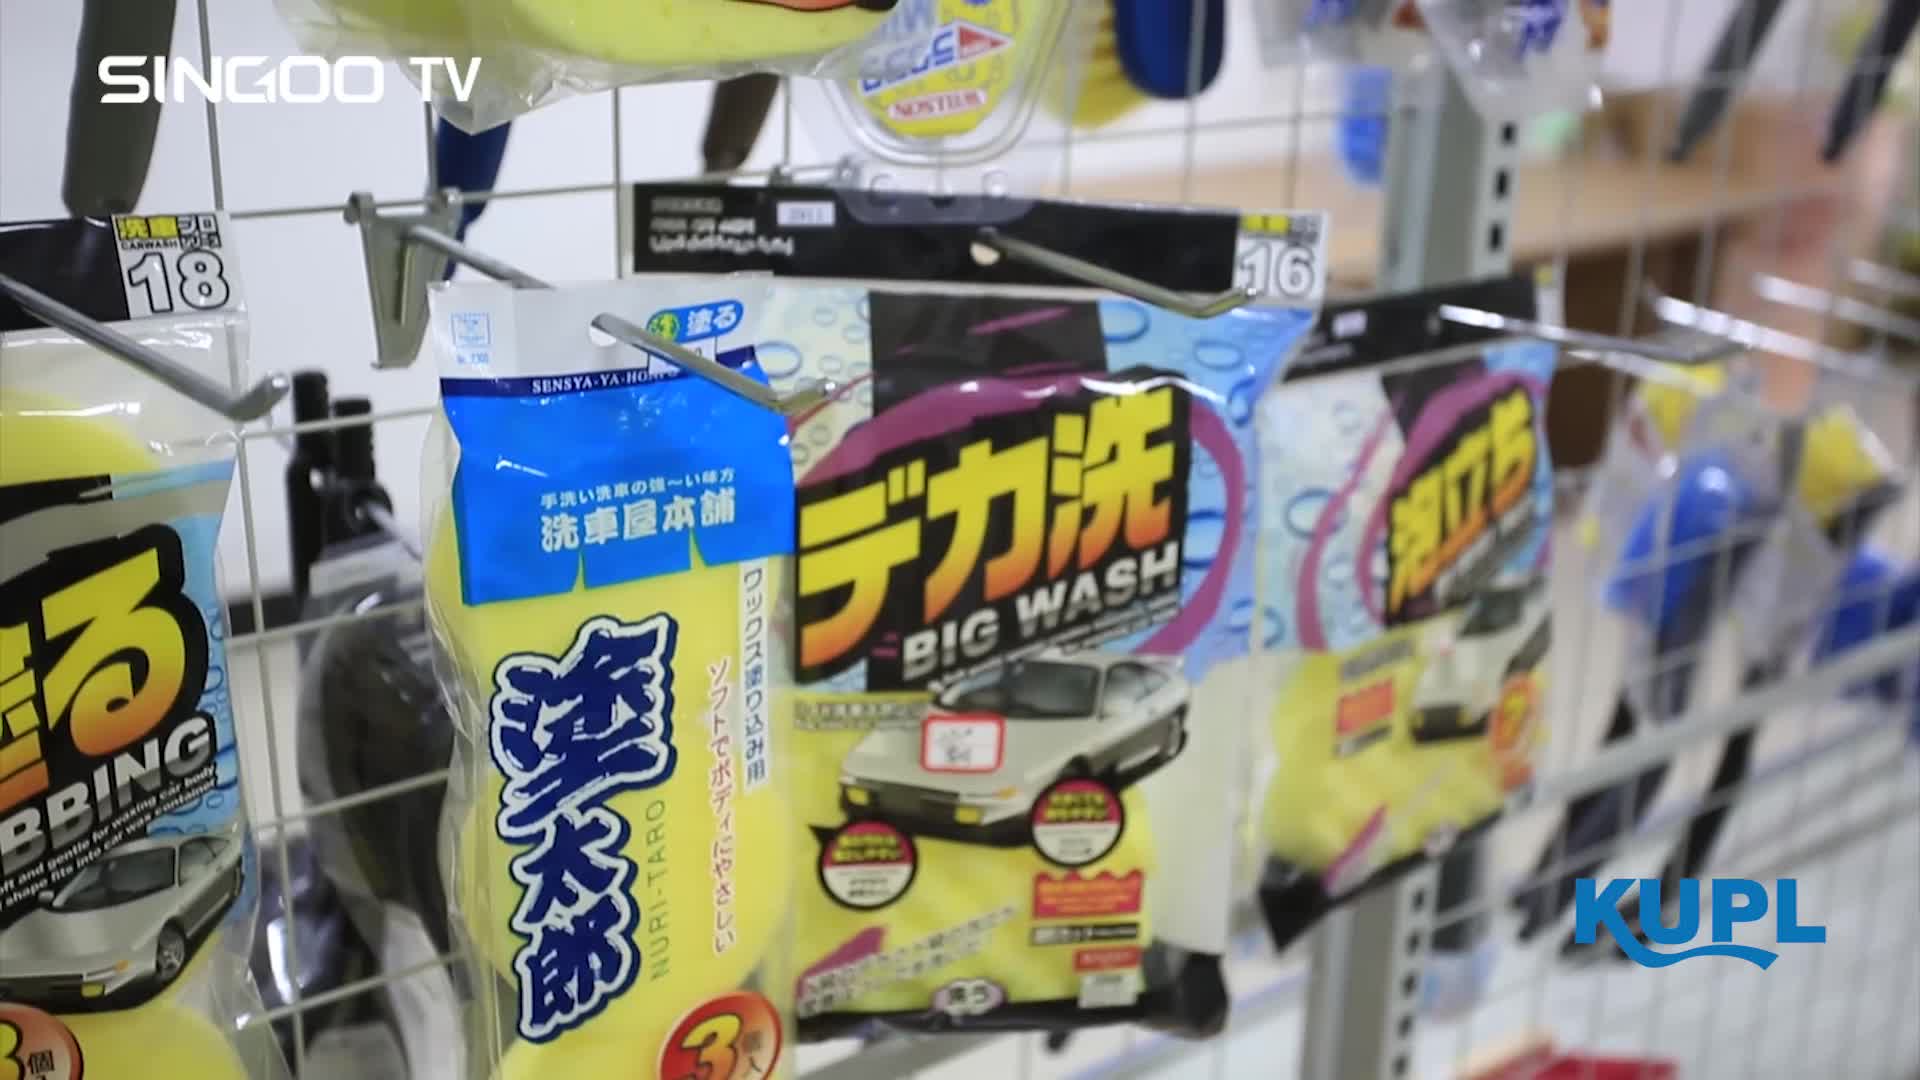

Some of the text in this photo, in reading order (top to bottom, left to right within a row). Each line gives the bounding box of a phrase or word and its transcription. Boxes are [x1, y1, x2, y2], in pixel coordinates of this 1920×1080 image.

[127, 250, 231, 314] 18
[1239, 241, 1316, 298] 16
[799, 387, 1174, 669] デカ洗
[903, 608, 1000, 682] BIG
[1016, 541, 1180, 637] WASH
[19, 862, 44, 885] and
[92, 825, 109, 845] for
